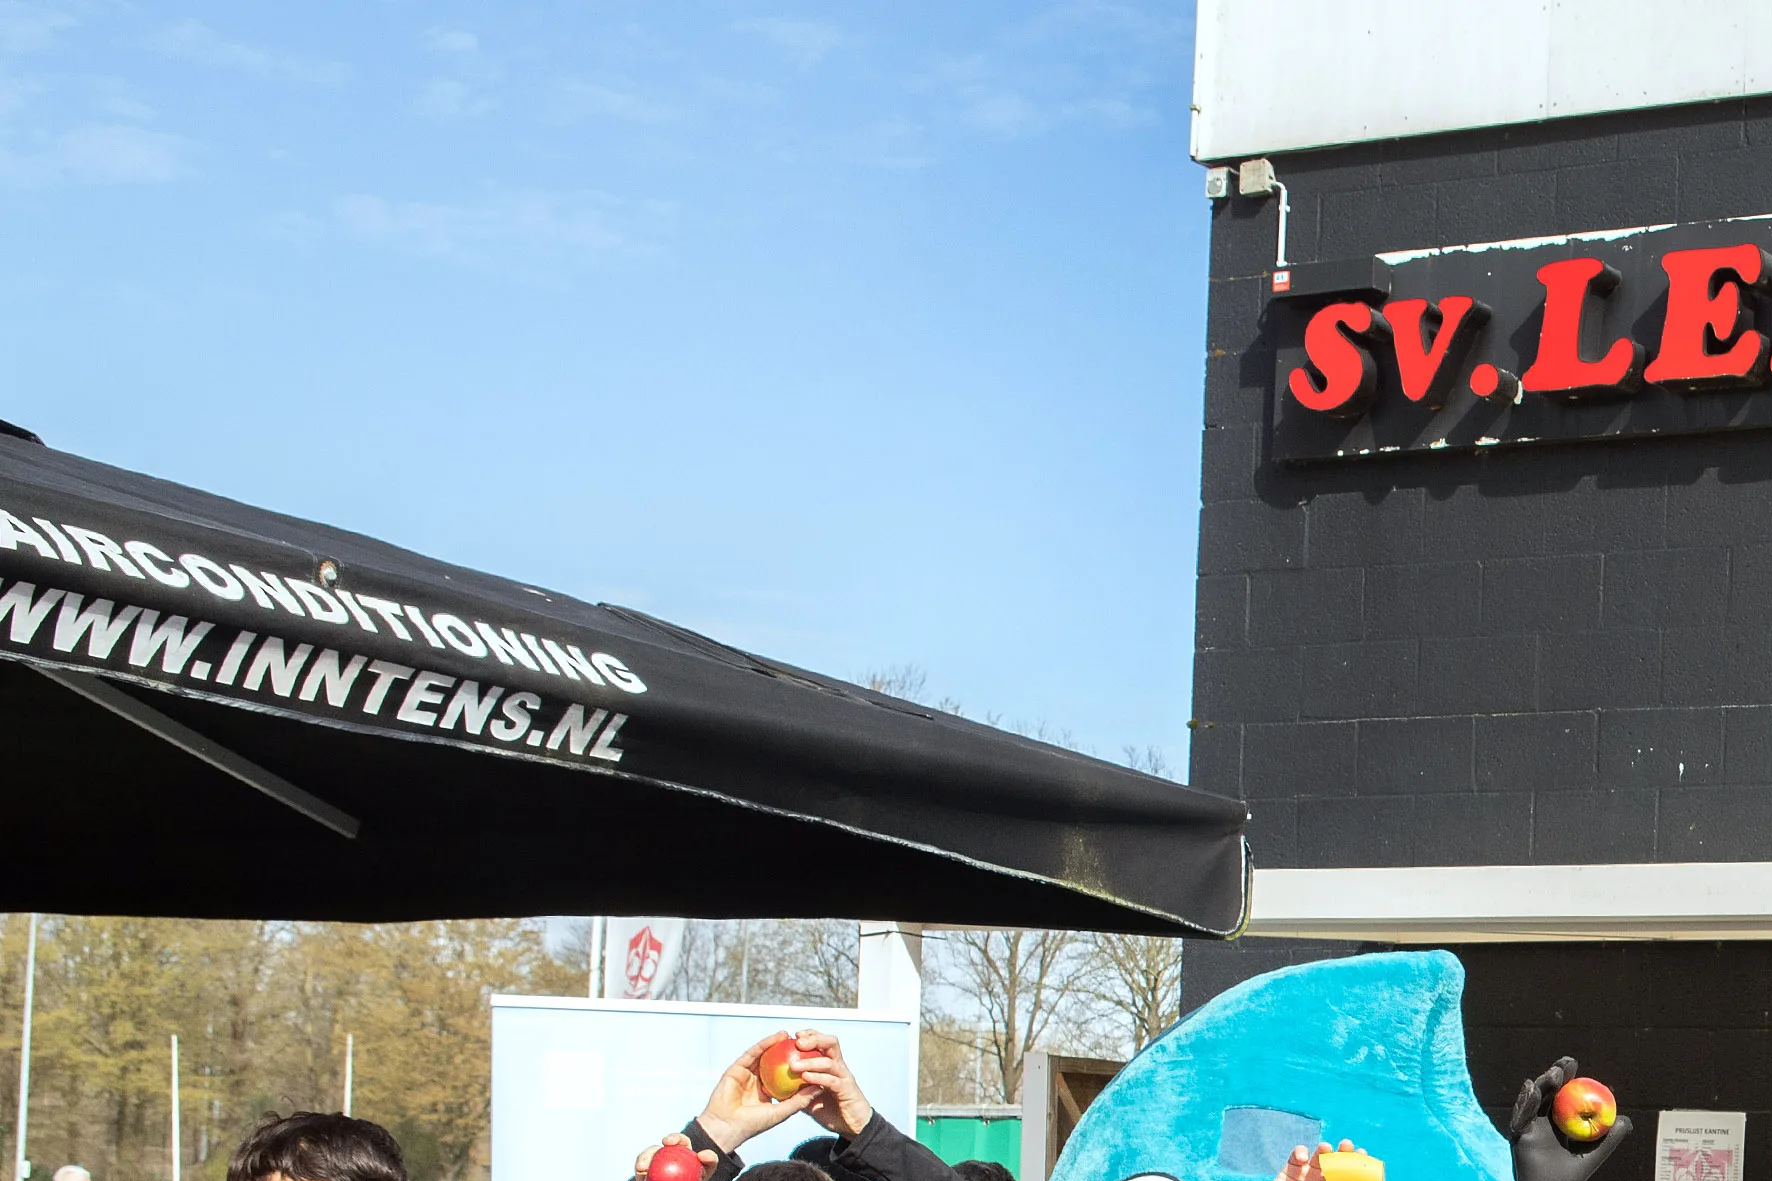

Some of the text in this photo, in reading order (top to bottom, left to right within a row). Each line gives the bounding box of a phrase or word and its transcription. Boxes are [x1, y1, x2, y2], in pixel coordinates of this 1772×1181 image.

[1289, 296, 1498, 411] SV.
[0, 508, 647, 694] AIRCONDITIONING
[0, 577, 628, 763] WWW.INNTENS.NL
[1704, 1128, 1730, 1136] KANTINE
